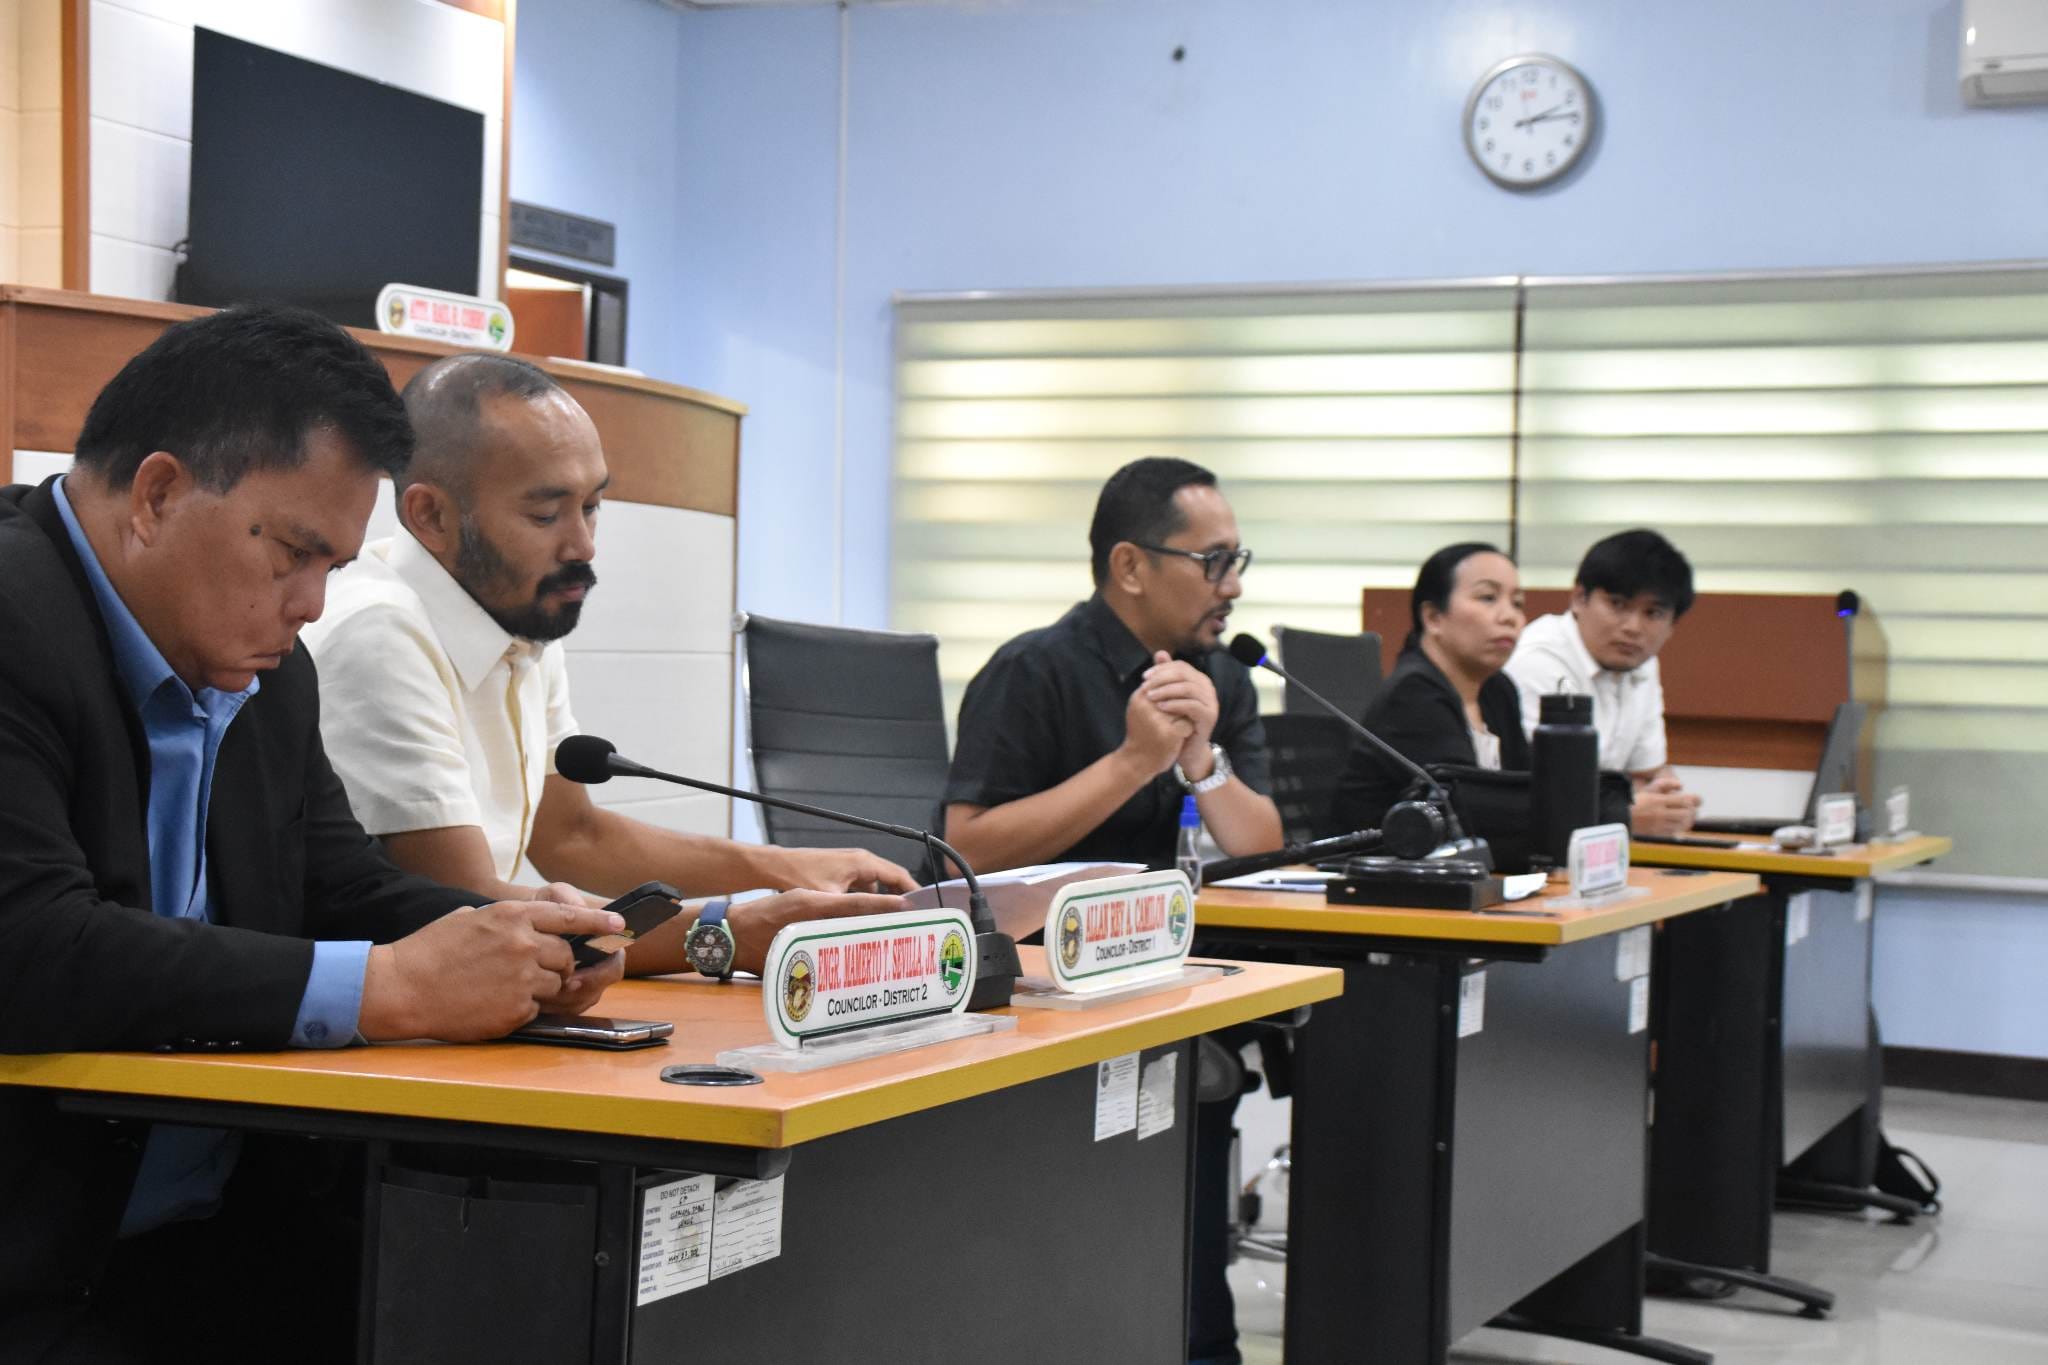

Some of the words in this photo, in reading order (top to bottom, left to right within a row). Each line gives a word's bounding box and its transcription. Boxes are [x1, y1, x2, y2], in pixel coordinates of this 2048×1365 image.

[1520, 68, 1539, 83] 12
[818, 948, 841, 992] ENGR.
[844, 941, 881, 989] MAMERTO
[884, 939, 891, 981] T.
[892, 935, 924, 982] SEVILLA,
[925, 933, 937, 976] JR.
[921, 984, 928, 1000] 2
[680, 1183, 700, 1195] DETACH
